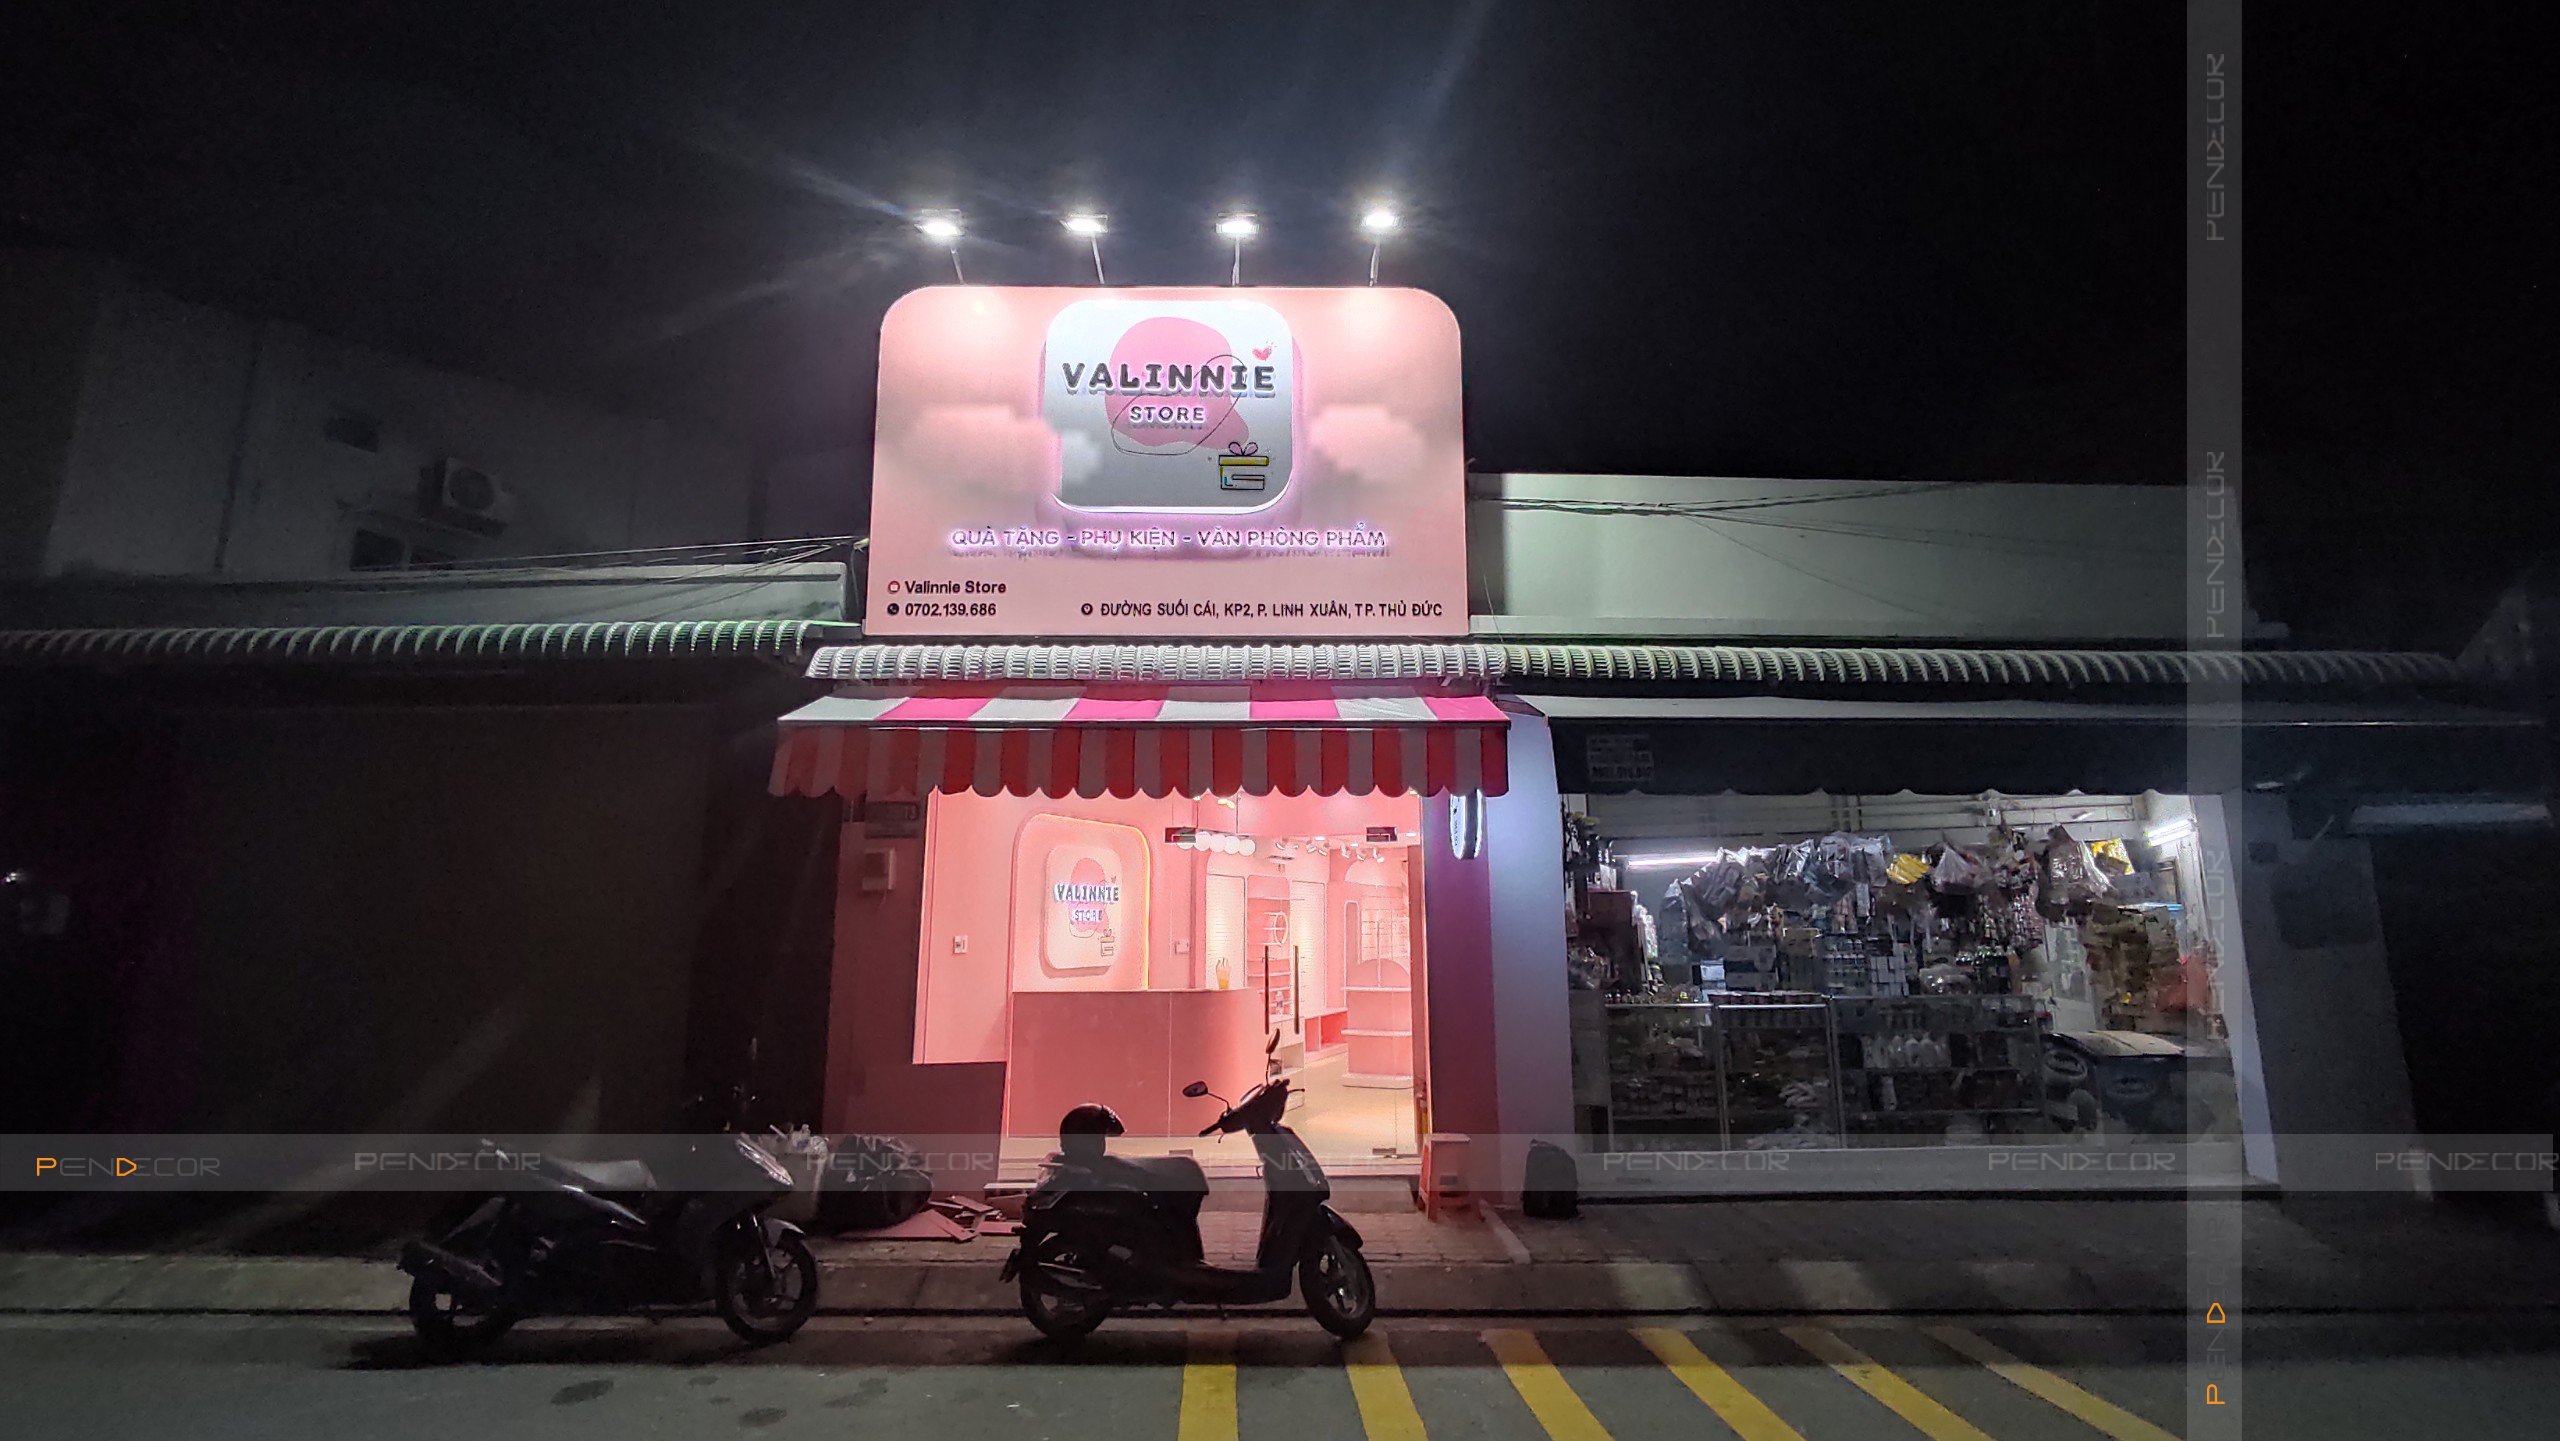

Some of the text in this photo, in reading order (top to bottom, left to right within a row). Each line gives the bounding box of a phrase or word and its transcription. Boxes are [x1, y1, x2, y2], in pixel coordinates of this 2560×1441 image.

[1062, 363, 1276, 393] VALINNIE
[1130, 406, 1205, 422] STORE
[951, 526, 996, 547] QUÀ
[1003, 526, 1060, 550] TẶNG
[1081, 530, 1123, 550] PHỤ
[1130, 526, 1176, 550] KIỆN
[1198, 525, 1241, 547] VĂN
[1247, 526, 1320, 547] PHÒNG
[1326, 521, 1386, 547] PHẨM
[905, 580, 1007, 595] Valinnie Store
[905, 602, 997, 617] 0702.139.686
[1100, 600, 1152, 617] ĐƯỜNG
[1193, 600, 1219, 619] CÁI,
[1224, 603, 1254, 618] KP2,
[1257, 603, 1268, 617] P.
[1272, 603, 1304, 617] LINH
[1310, 600, 1351, 619] XUÂN,
[1379, 600, 1407, 617] THỦ
[1411, 600, 1443, 617] ĐỨC
[1056, 883, 1119, 902] VALINNIE
